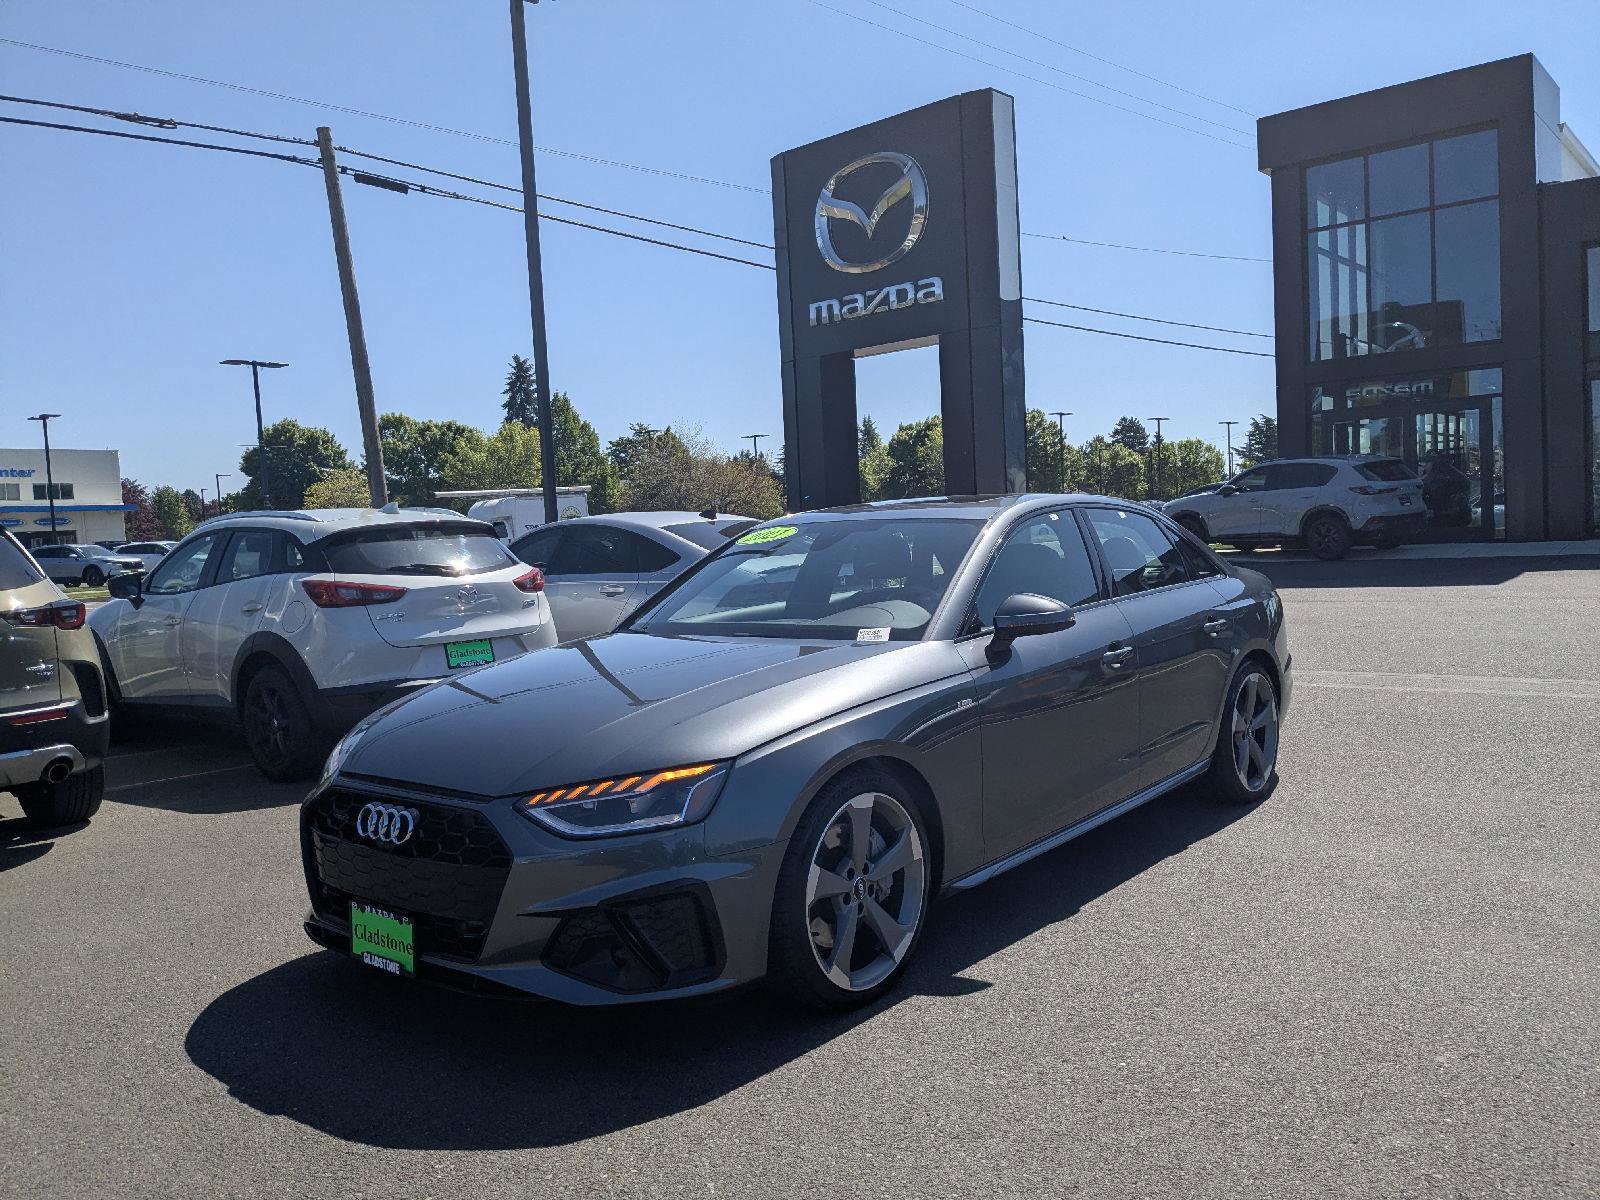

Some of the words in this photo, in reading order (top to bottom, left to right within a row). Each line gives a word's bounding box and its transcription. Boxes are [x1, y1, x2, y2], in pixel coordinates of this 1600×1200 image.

[808, 275, 944, 327] mazda
[449, 648, 492, 659] Gladstone
[354, 923, 414, 956] Gladstone
[363, 951, 400, 975] GLADSTONE
